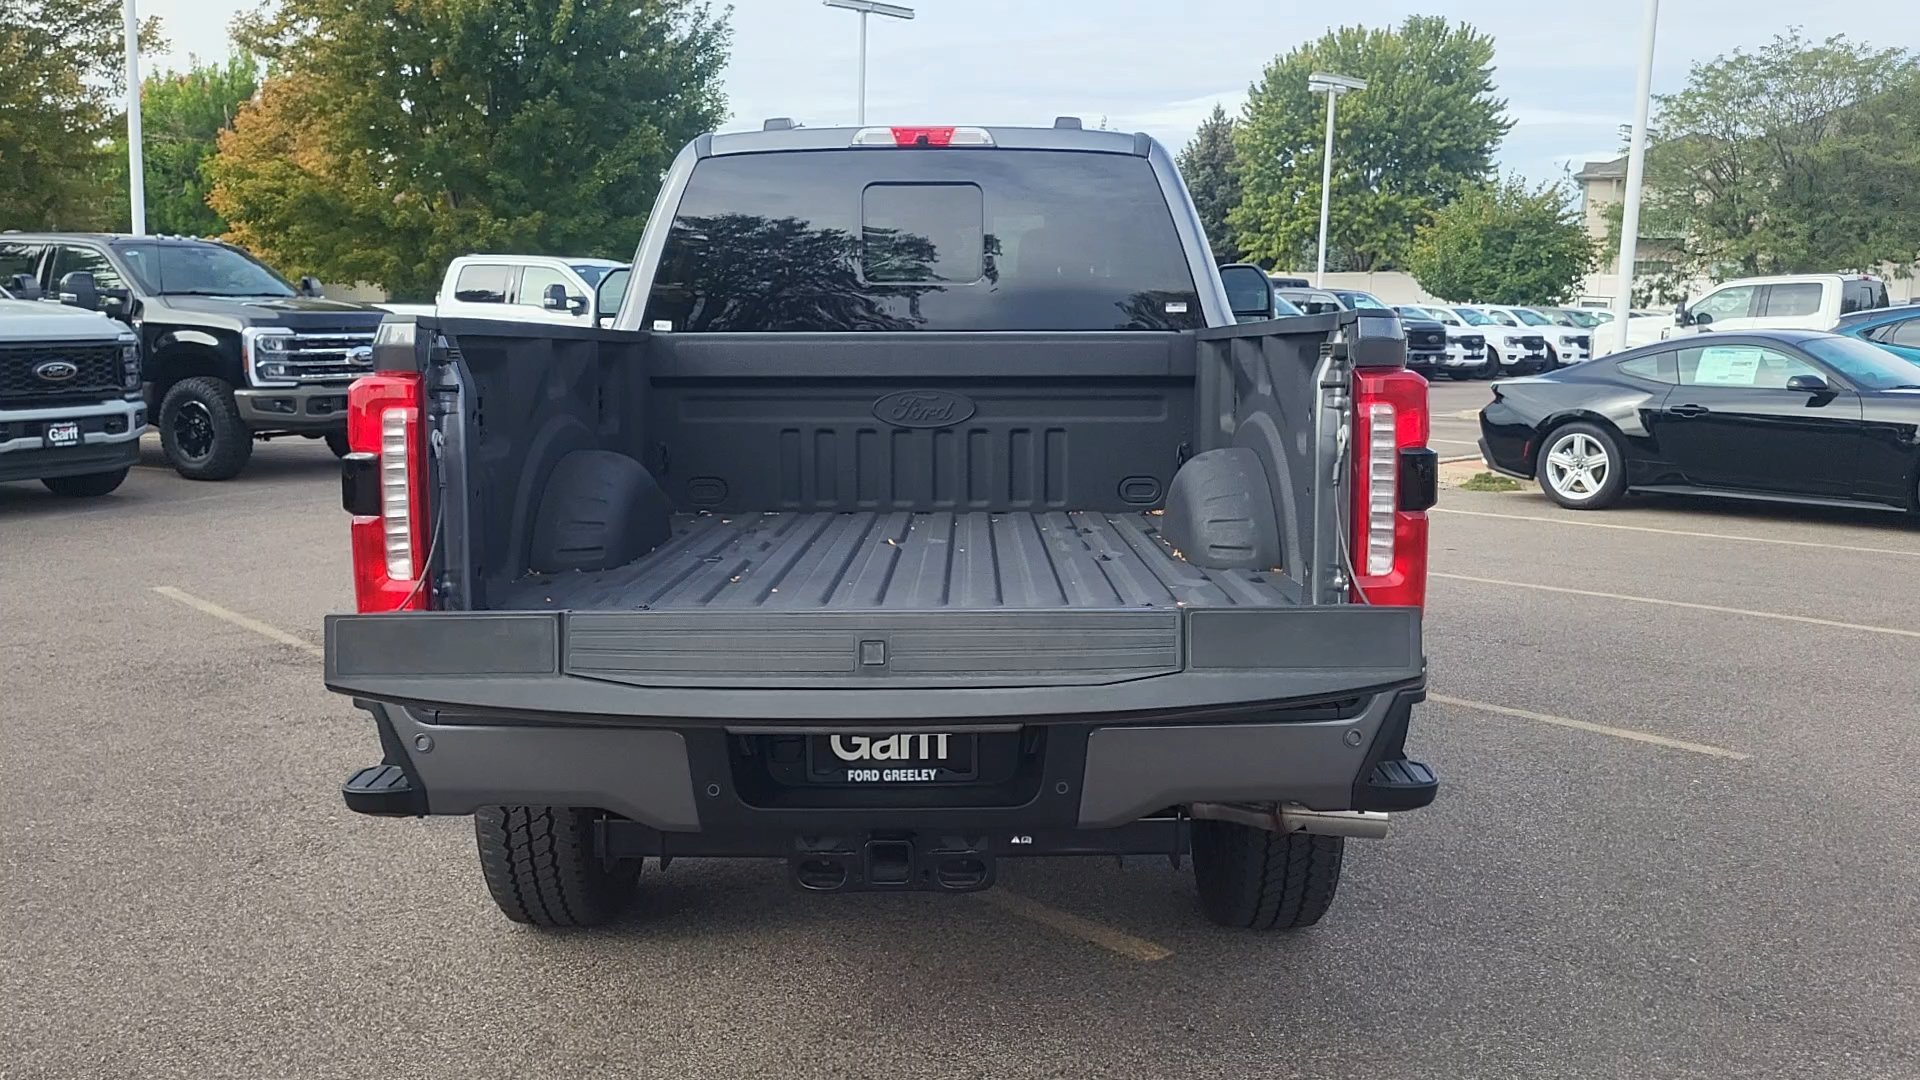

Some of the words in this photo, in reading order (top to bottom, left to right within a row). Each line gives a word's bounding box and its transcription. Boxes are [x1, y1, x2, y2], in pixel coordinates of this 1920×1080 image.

[892, 393, 954, 420] Ford
[49, 427, 78, 441] Garff
[848, 769, 880, 781] FORD
[883, 769, 936, 781] GREELEY
